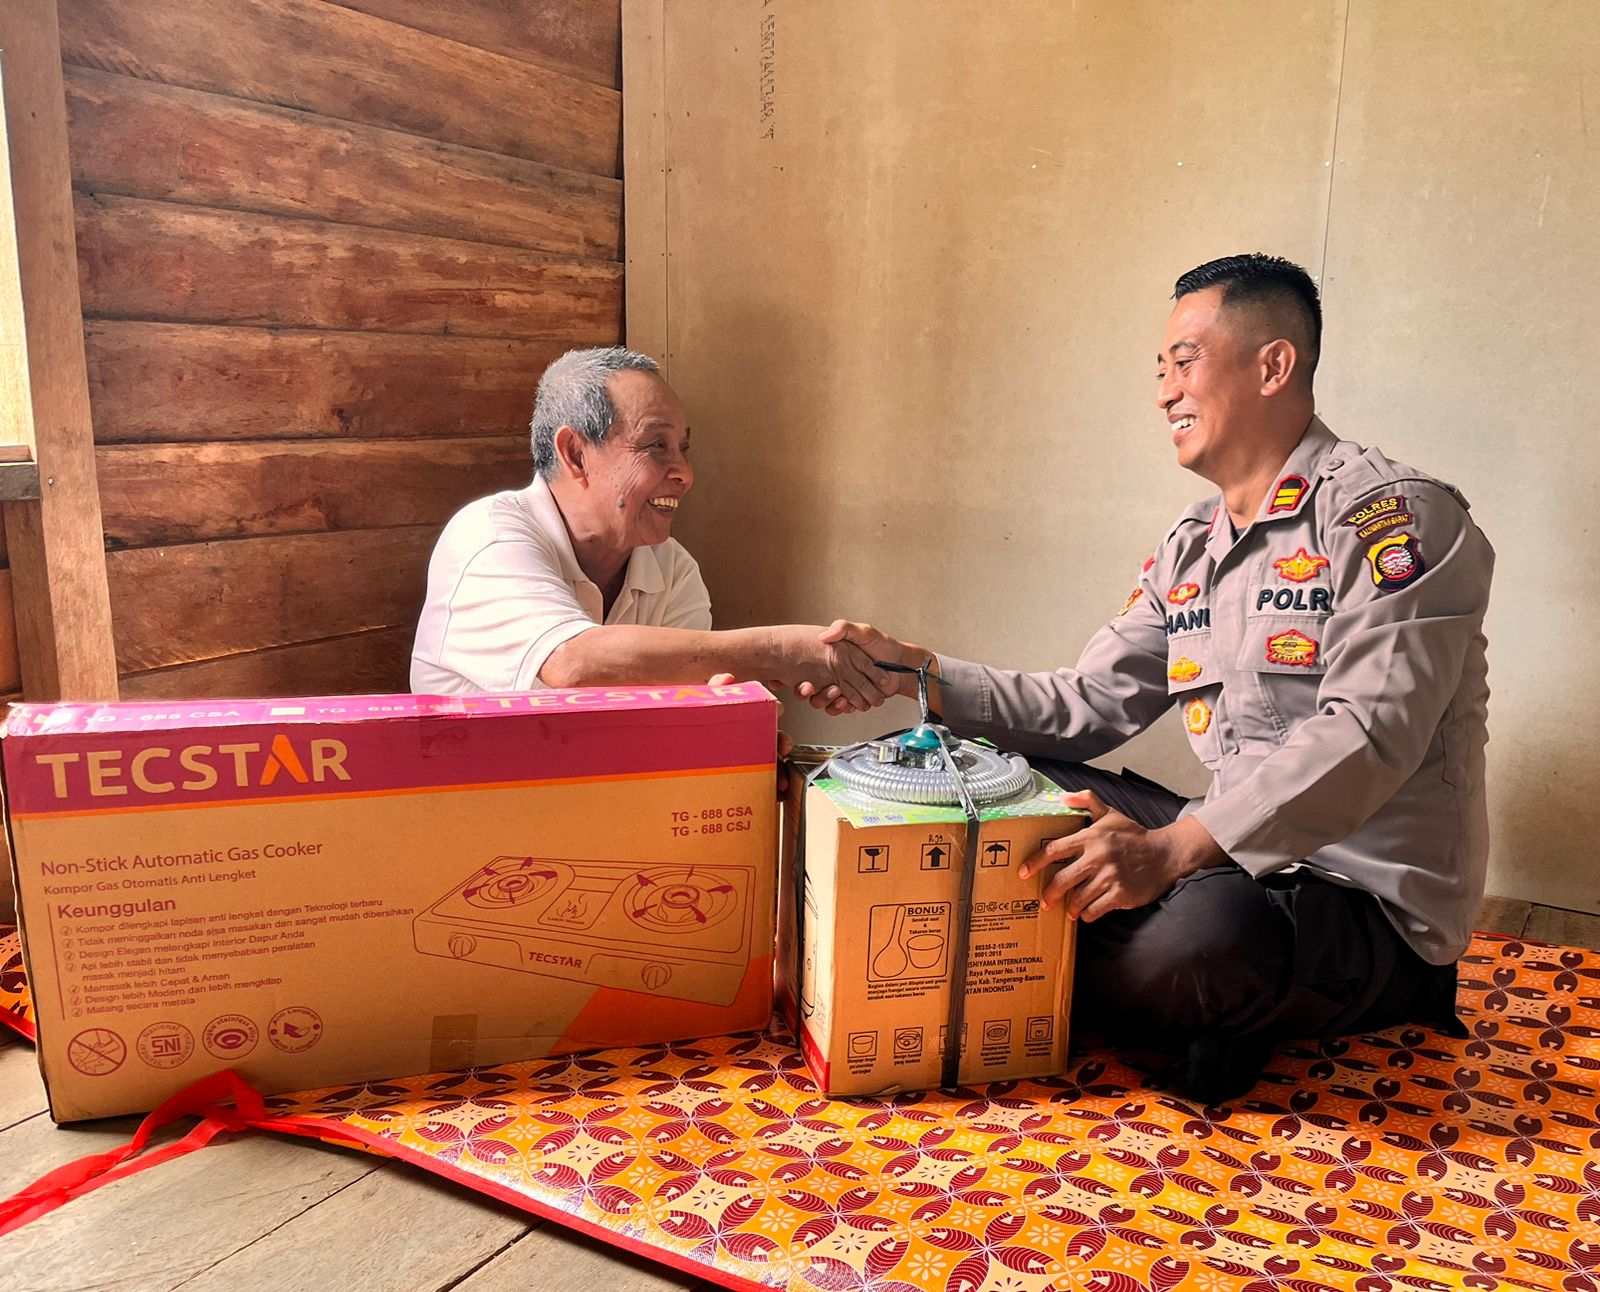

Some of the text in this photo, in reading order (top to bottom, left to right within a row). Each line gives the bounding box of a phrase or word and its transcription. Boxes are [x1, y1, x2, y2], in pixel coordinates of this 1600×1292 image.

[1348, 498, 1398, 523] POLRES
[1256, 587, 1330, 612] POLR
[486, 684, 748, 709] TECSTAR
[35, 734, 351, 799] TECSTAR
[671, 811, 690, 822] TG
[701, 808, 723, 820] 688
[726, 806, 753, 817] CSA
[671, 826, 690, 837] TG
[701, 823, 723, 834] 688
[726, 820, 751, 832] CSJ
[40, 841, 323, 876] Non-Stick Automatic Gas Cooker
[44, 869, 257, 896] Kompor Gas Otomatis Anti Lengket
[57, 898, 177, 919] Keunggulan
[76, 899, 383, 934] Kompor dilengkapi lapisan anti lengket dengan Teknologi terbaru
[907, 905, 946, 915] BONUS
[78, 907, 414, 946] Tidak meninggalkan noda sisa masakan dan sangat mudah dibersihkan
[78, 930, 305, 960] Design Elegan melengkapi Interior Dapur Anda
[80, 940, 316, 971] Api lebih stabil dan tidak menyebabkan peralatan
[528, 951, 582, 969] TECSTAR
[997, 956, 1044, 966] INTERNATIONAL
[82, 966, 186, 982] masak menjadi hitam
[83, 972, 231, 993] Memasak lebih Cepat & Aman
[969, 969, 983, 978] Raya
[85, 993, 120, 1004] Design
[122, 990, 146, 1000] lebih
[148, 987, 186, 998] Modern
[188, 985, 207, 994] dan
[209, 981, 232, 992] lebih
[982, 984, 1015, 993] INDONESIA
[86, 997, 196, 1015] Matang secara merata
[151, 1037, 182, 1054] SNI
